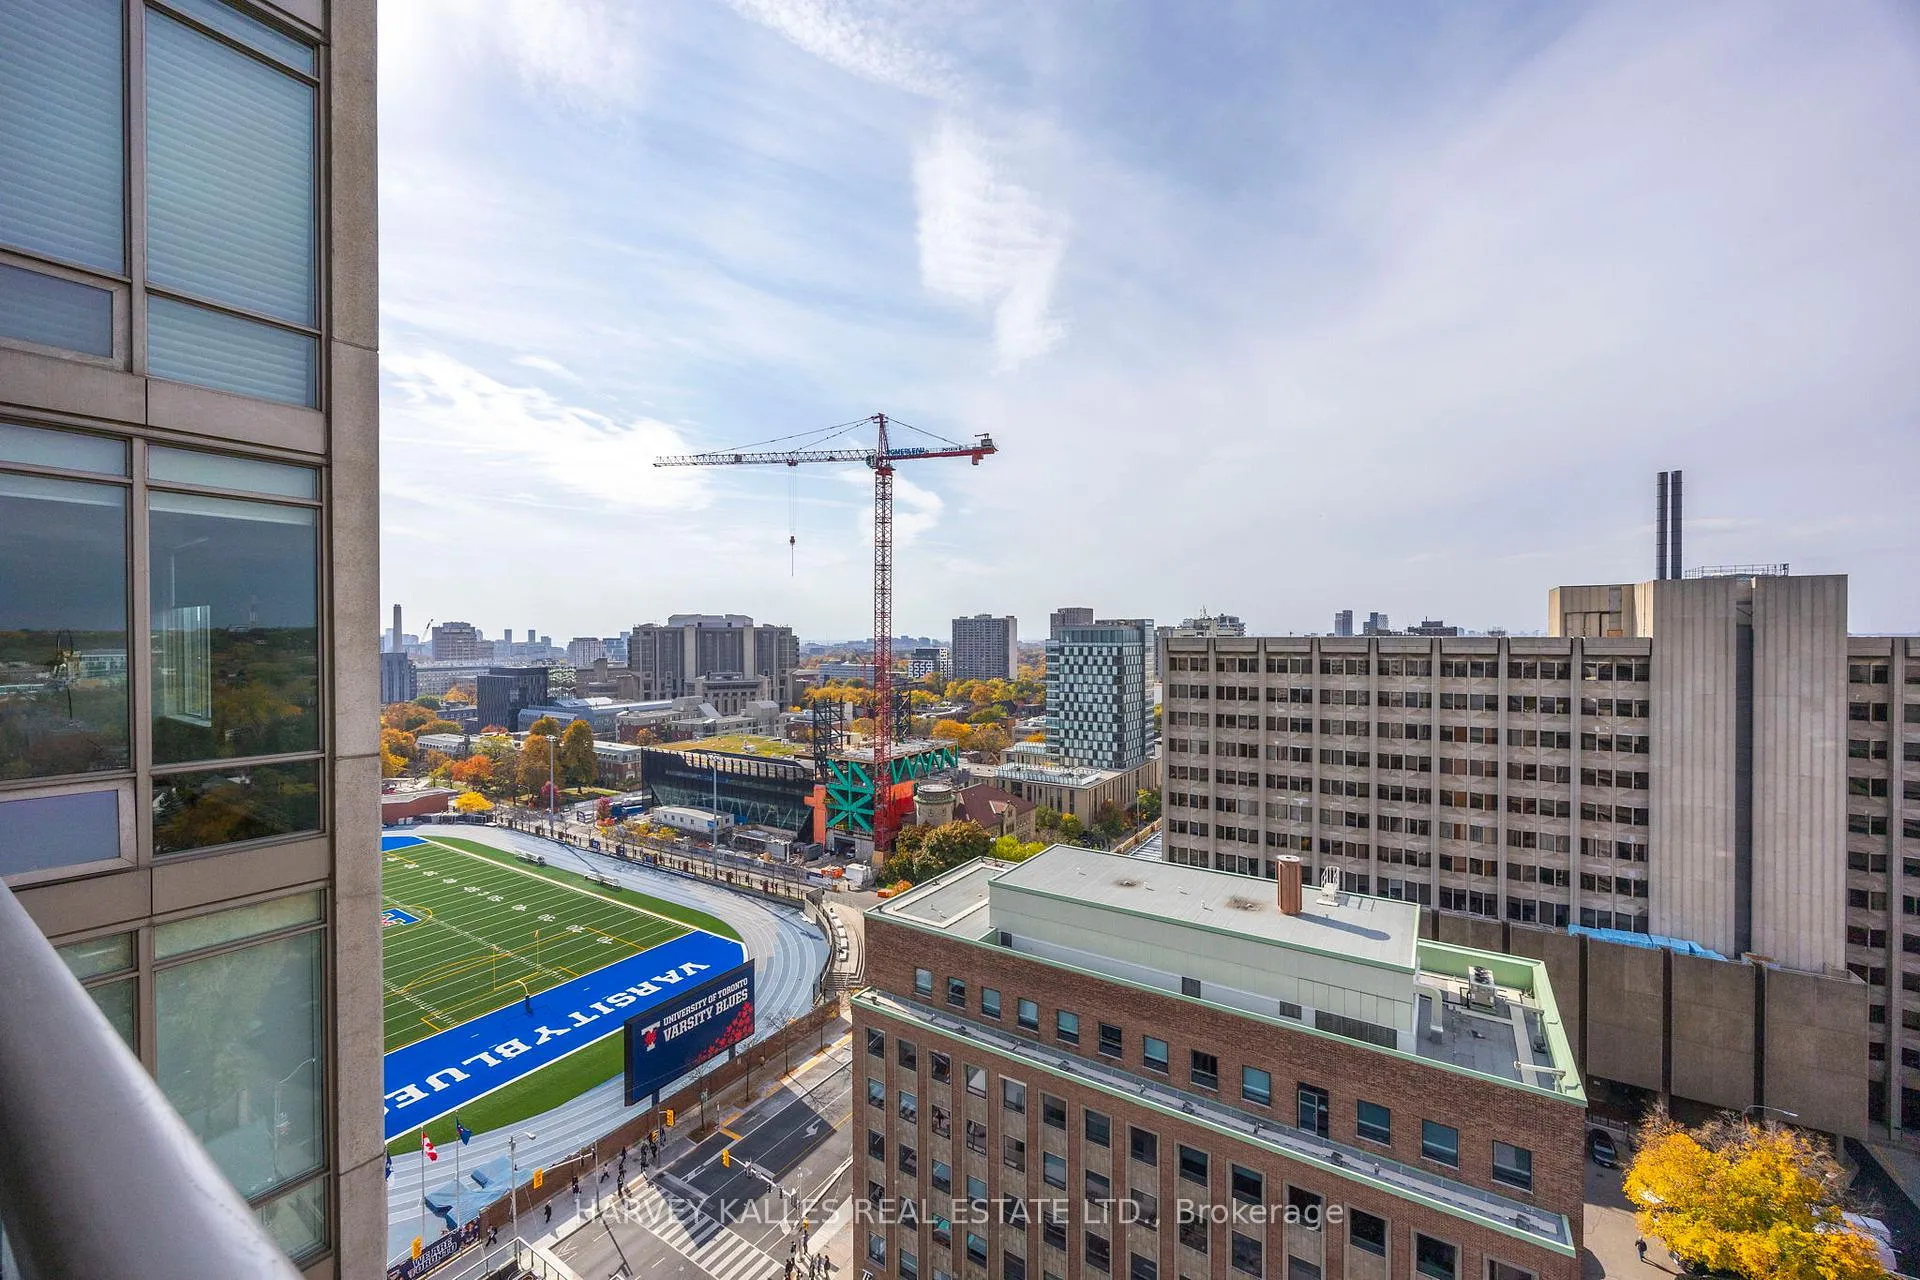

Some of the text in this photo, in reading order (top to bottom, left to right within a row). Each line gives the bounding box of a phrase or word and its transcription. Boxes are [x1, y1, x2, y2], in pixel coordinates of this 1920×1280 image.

[663, 977, 748, 1026] UNIVERSITY OF TORONTO
[663, 988, 748, 1042] VARSITY BLUES
[384, 962, 711, 1116] VARSITY BLUE
[407, 1242, 458, 1279] TORONTO
[413, 1238, 453, 1268] WE ARE
